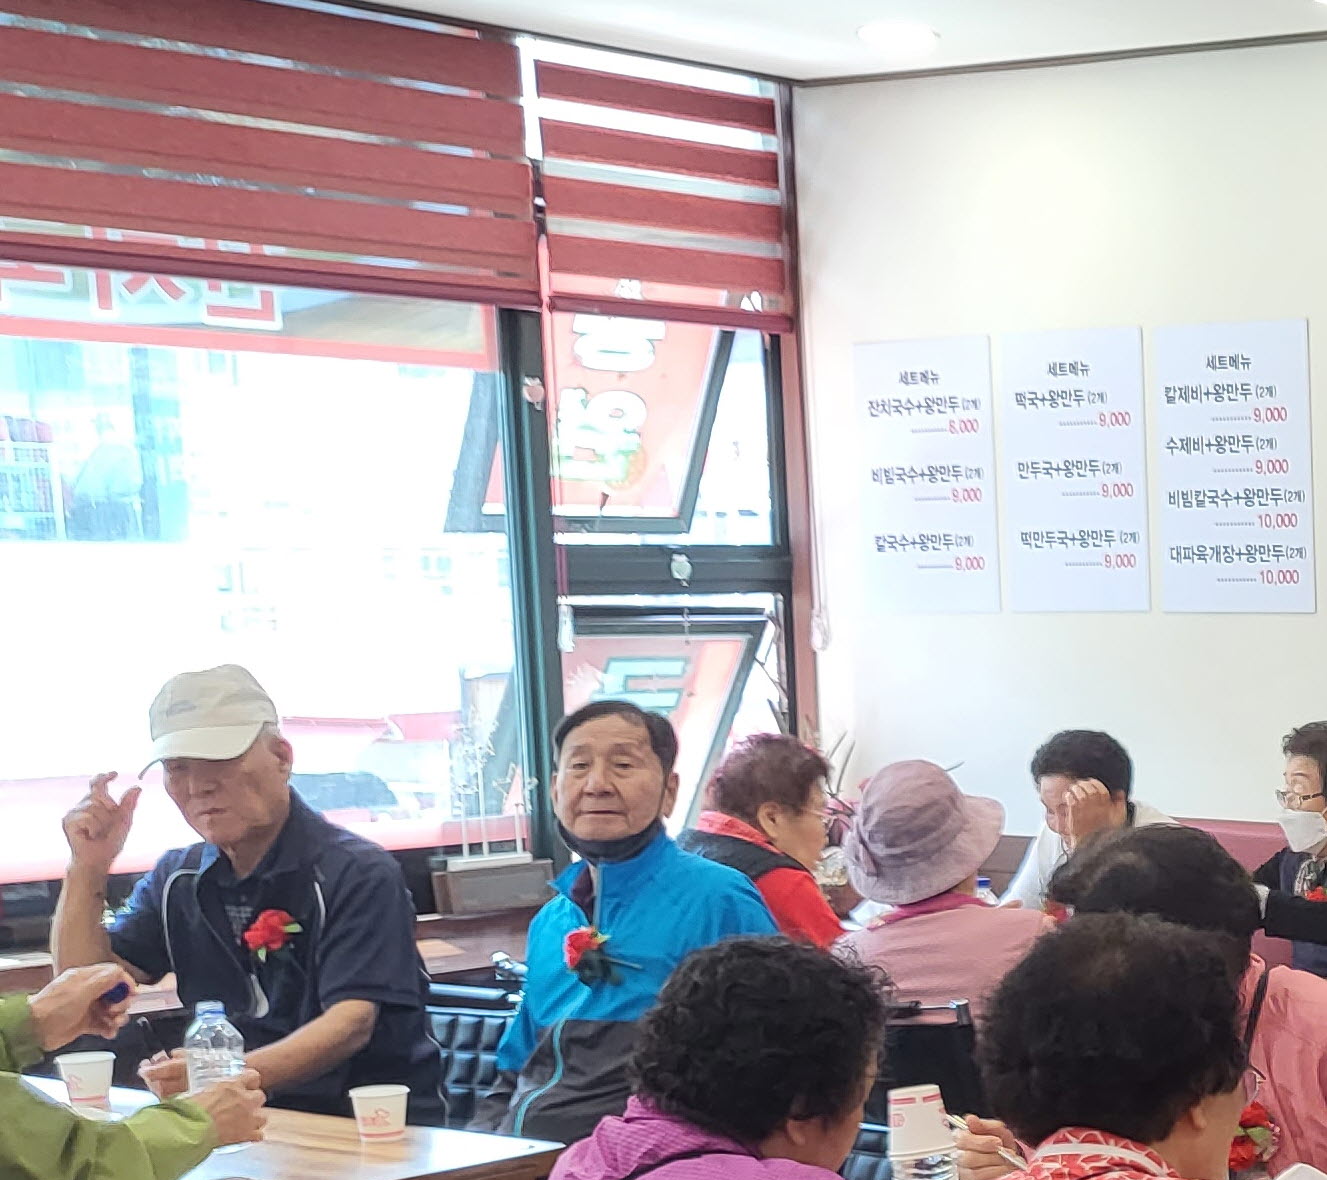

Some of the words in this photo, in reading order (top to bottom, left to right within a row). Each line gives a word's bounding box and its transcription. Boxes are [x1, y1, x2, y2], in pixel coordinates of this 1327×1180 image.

[1047, 361, 1090, 376] 세트메뉴
[1206, 354, 1251, 370] 세트메뉴
[1099, 412, 1131, 427] 9,000
[1250, 407, 1287, 422] 9,000
[1256, 459, 1288, 474] 9,000
[952, 488, 982, 502] 9,000
[1099, 483, 1133, 497] 9,000
[1258, 513, 1297, 529] 10,000
[952, 557, 985, 570] 9,000
[1105, 554, 1136, 568] 9,000
[1260, 570, 1299, 585] 10,000
